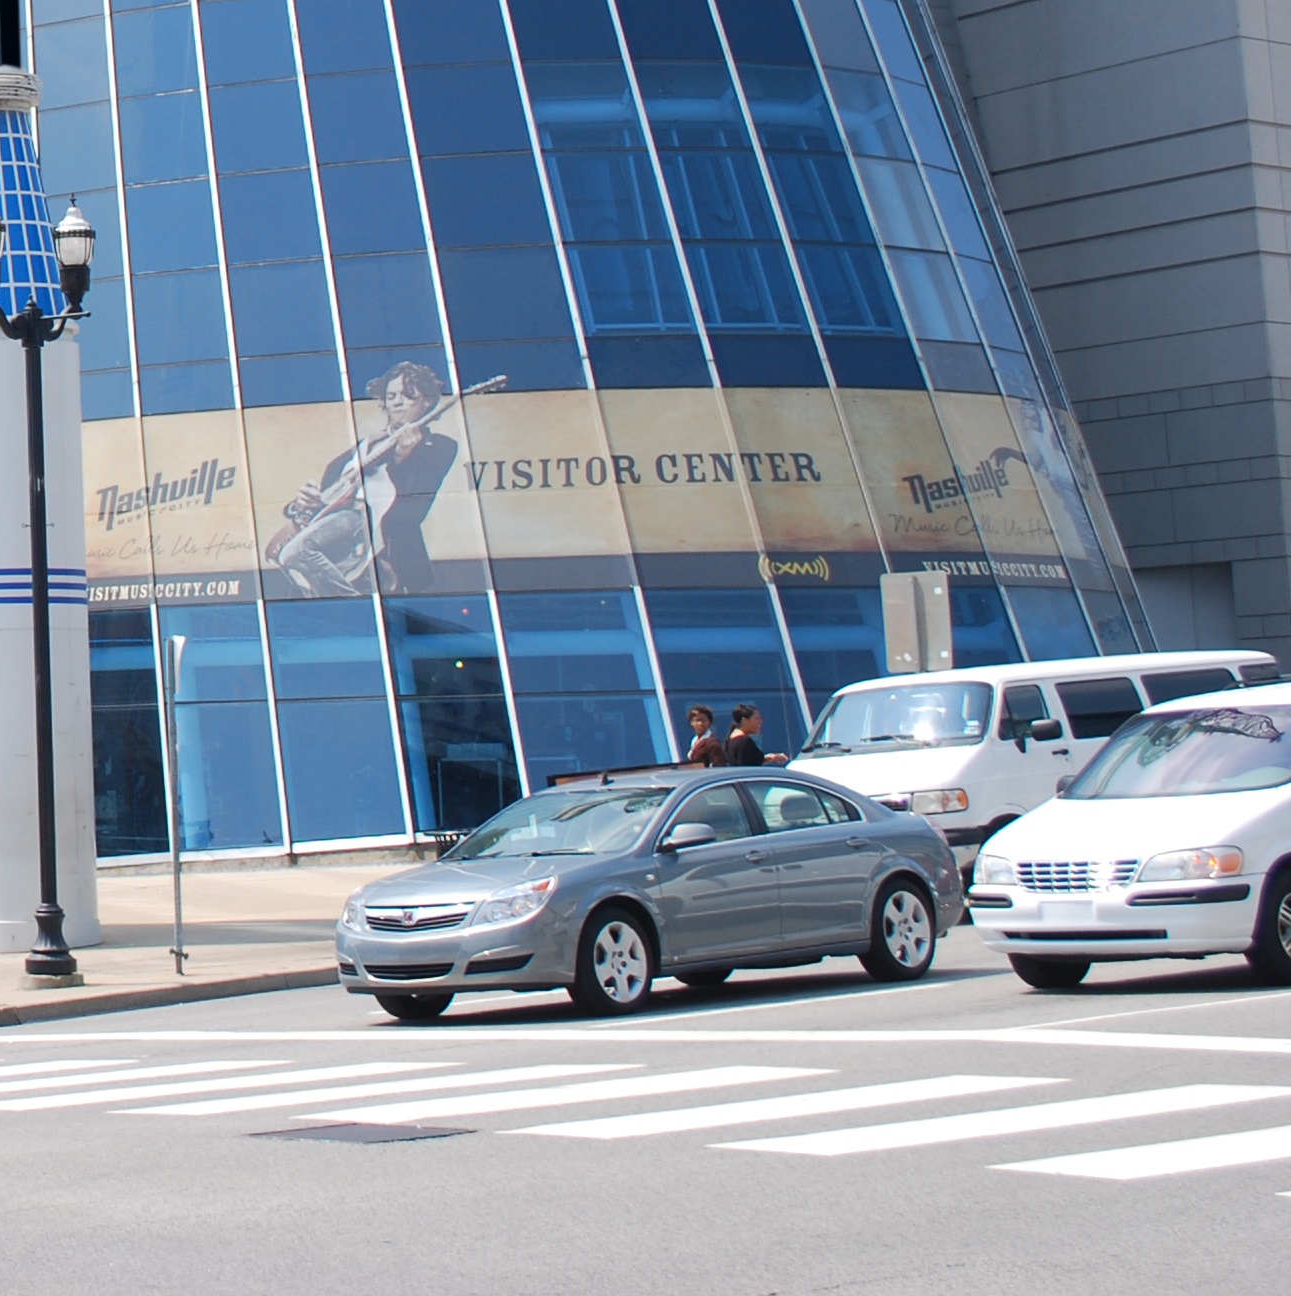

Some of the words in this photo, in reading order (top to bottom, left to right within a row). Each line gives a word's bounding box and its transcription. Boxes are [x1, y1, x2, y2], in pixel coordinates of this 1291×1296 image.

[463, 454, 641, 491] VISITOR
[655, 452, 822, 483] CENTER
[96, 458, 236, 531] Nashville
[87, 547, 116, 558] usic
[170, 533, 200, 556] Us
[87, 580, 240, 602] ISITMUSICCITY.COM
